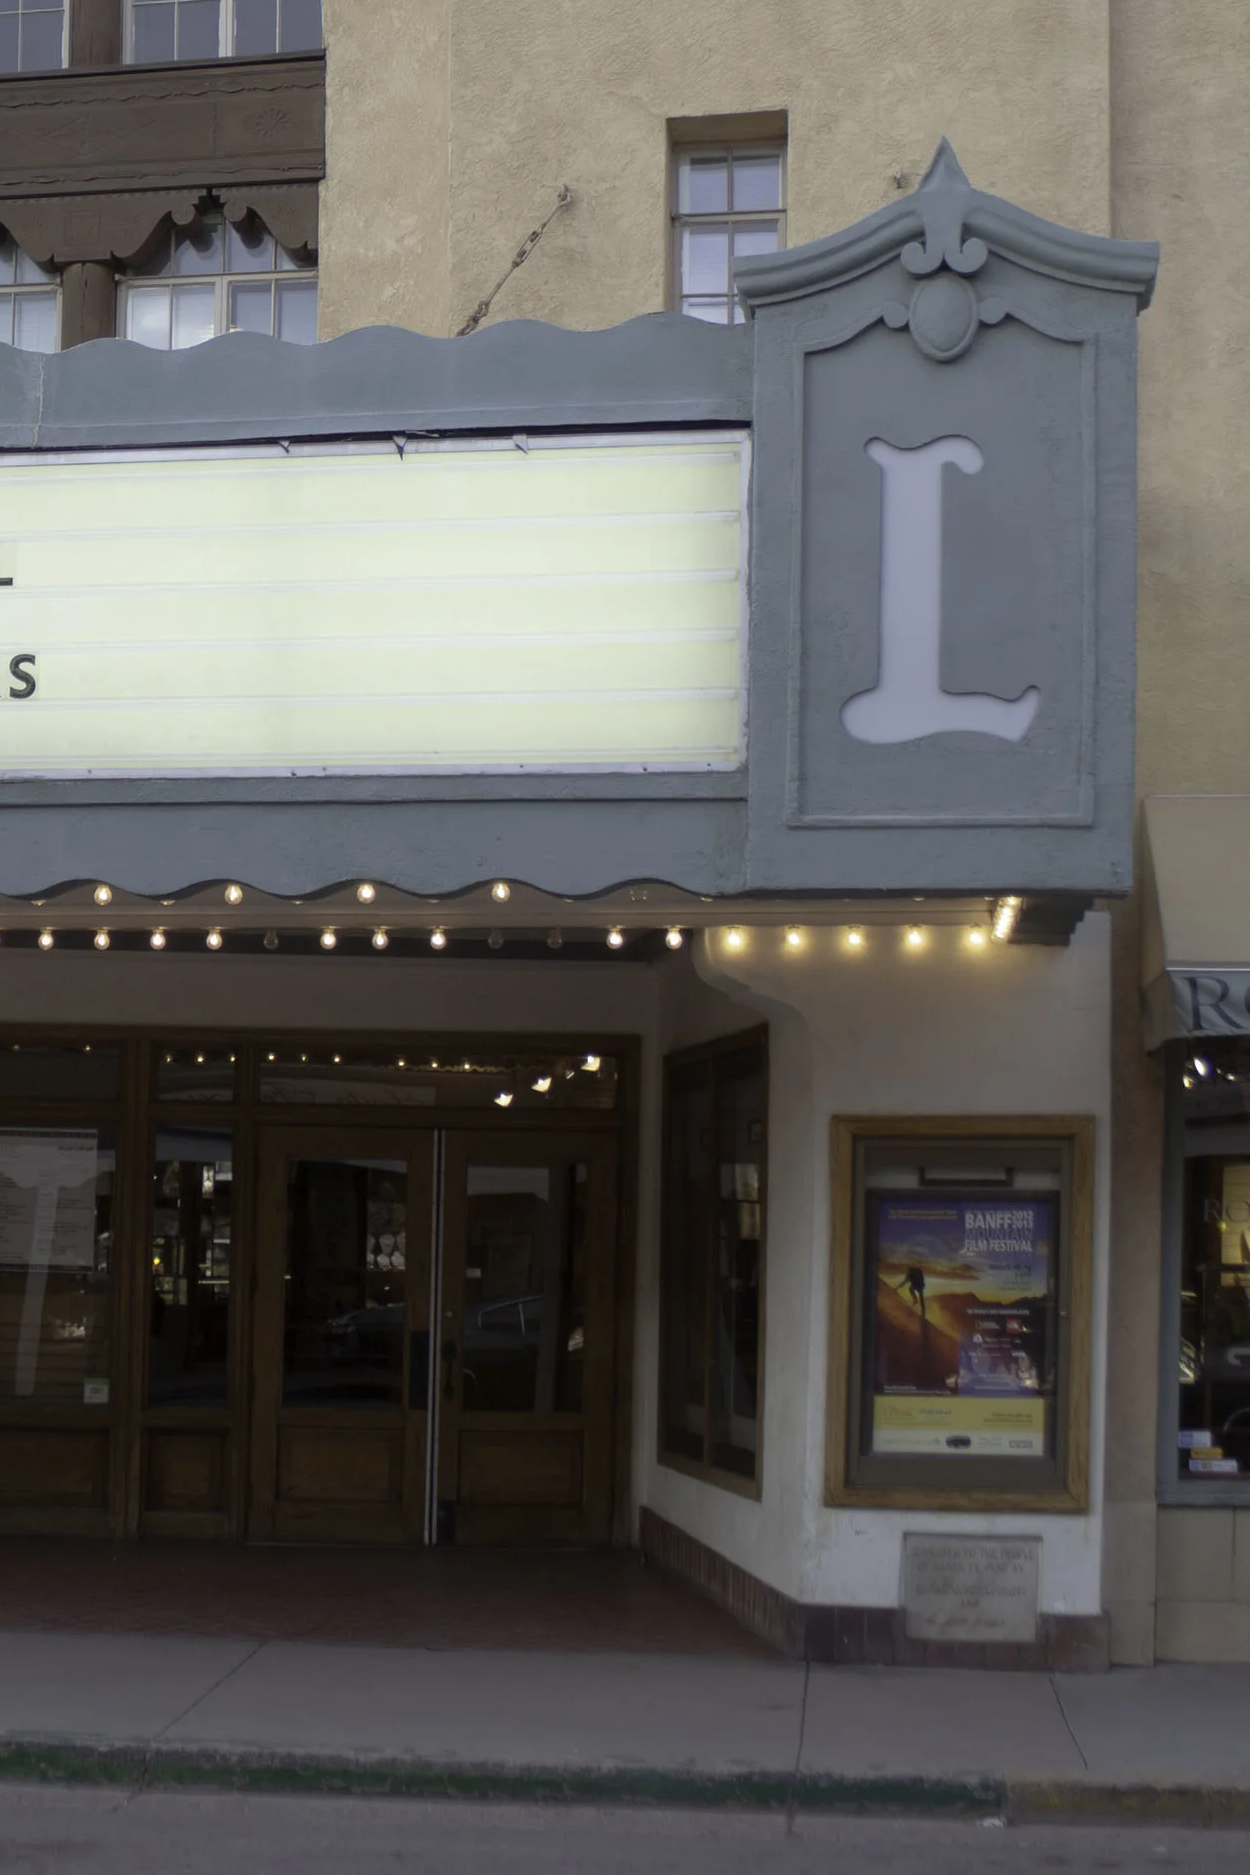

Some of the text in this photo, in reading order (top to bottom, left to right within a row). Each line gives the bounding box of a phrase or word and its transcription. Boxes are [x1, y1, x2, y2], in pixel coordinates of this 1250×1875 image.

[1180, 976, 1250, 1032] R
[965, 1212, 1012, 1229] BANFF
[965, 1239, 1033, 1252] FILM FESTIVAL
